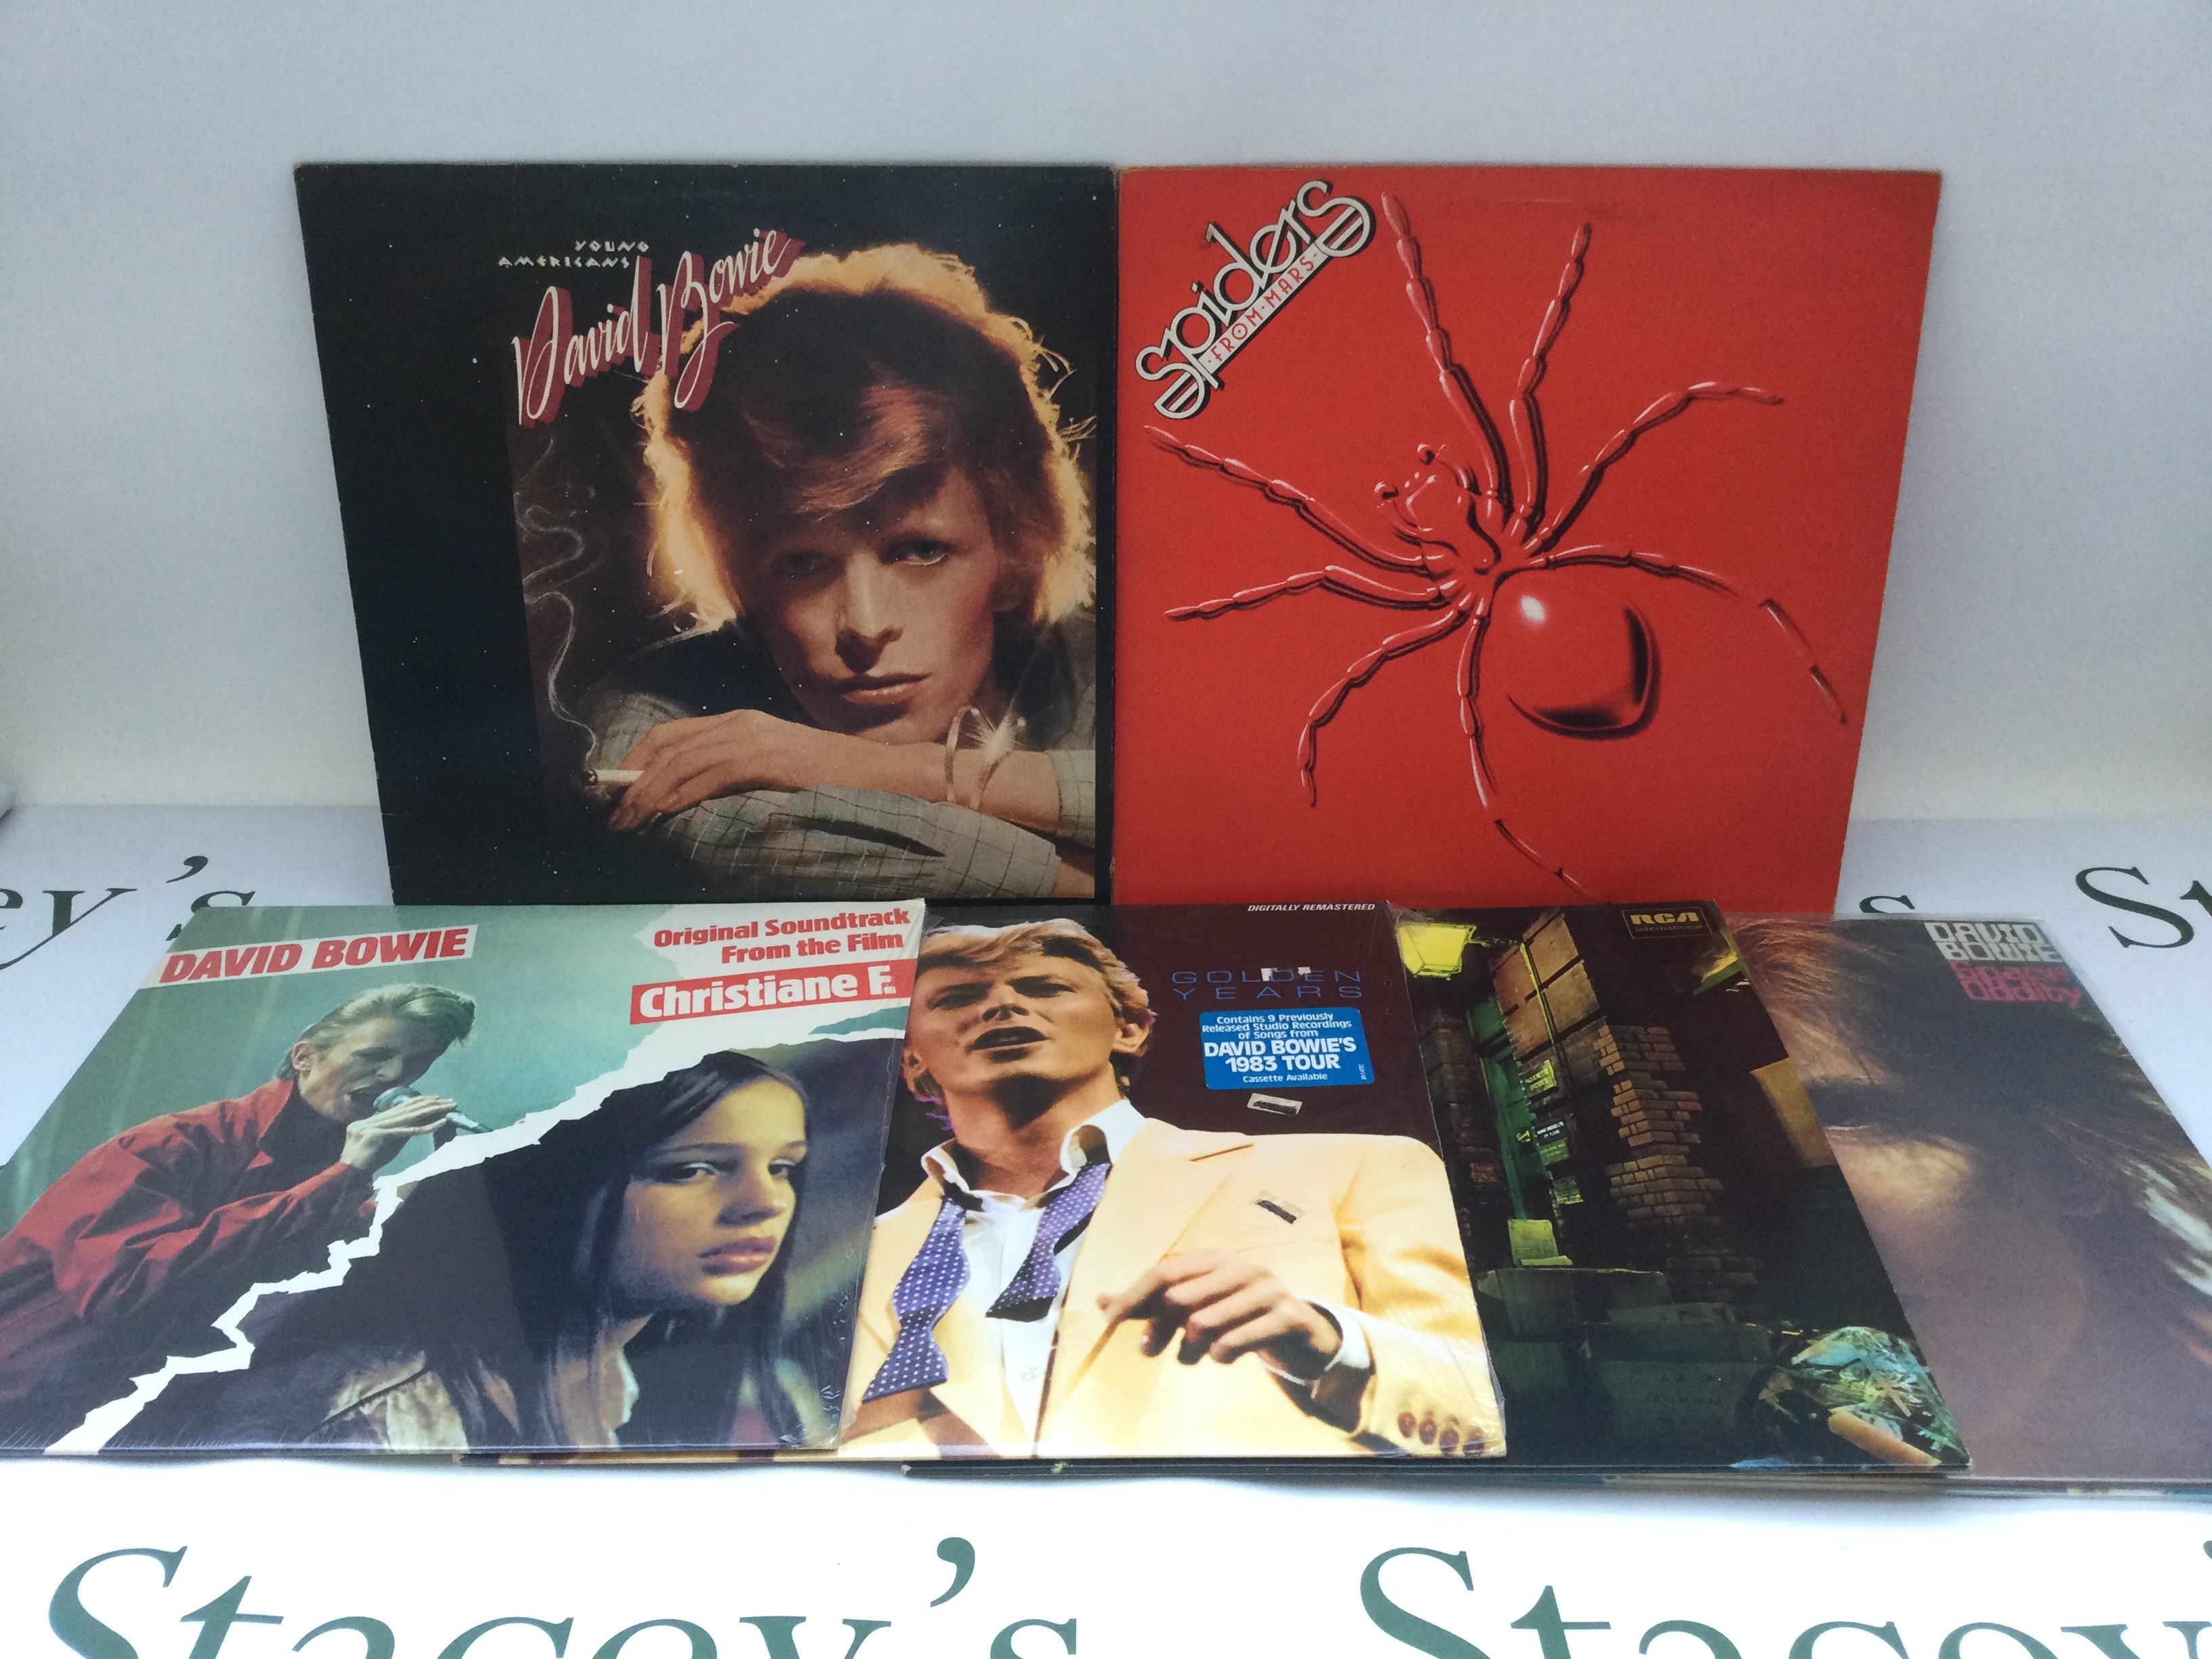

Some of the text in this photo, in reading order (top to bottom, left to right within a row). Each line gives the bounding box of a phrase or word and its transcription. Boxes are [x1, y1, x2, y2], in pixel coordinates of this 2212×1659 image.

[575, 240, 649, 253] YOUNG
[498, 256, 630, 268] AMERICANS
[1210, 255, 1315, 362] FROM MARS
[512, 228, 800, 427] David Bowie
[1247, 903, 1376, 912] DIGITALLY REMASTERED
[654, 908, 911, 948] Original Soundtrack
[1630, 912, 1700, 925] RCA
[1923, 922, 2044, 943] DAVID
[159, 927, 469, 984] DAVID BOWIE
[721, 932, 904, 964] From the Film
[1936, 941, 2064, 962] BOWIE
[639, 964, 897, 1018] Christiane F.
[1173, 985, 1363, 1000] YEARS
[1202, 1020, 1352, 1033] Released Studio Recordings
[1216, 1015, 1266, 1025] Contains
[1278, 1012, 1334, 1022] Previously
[1237, 1029, 1319, 1040] of Songs from
[1204, 1037, 1357, 1057] DAVID BOWIE'S
[1225, 1054, 1341, 1073] 1983 TOUR
[1242, 1073, 1328, 1084] Cassette Available
